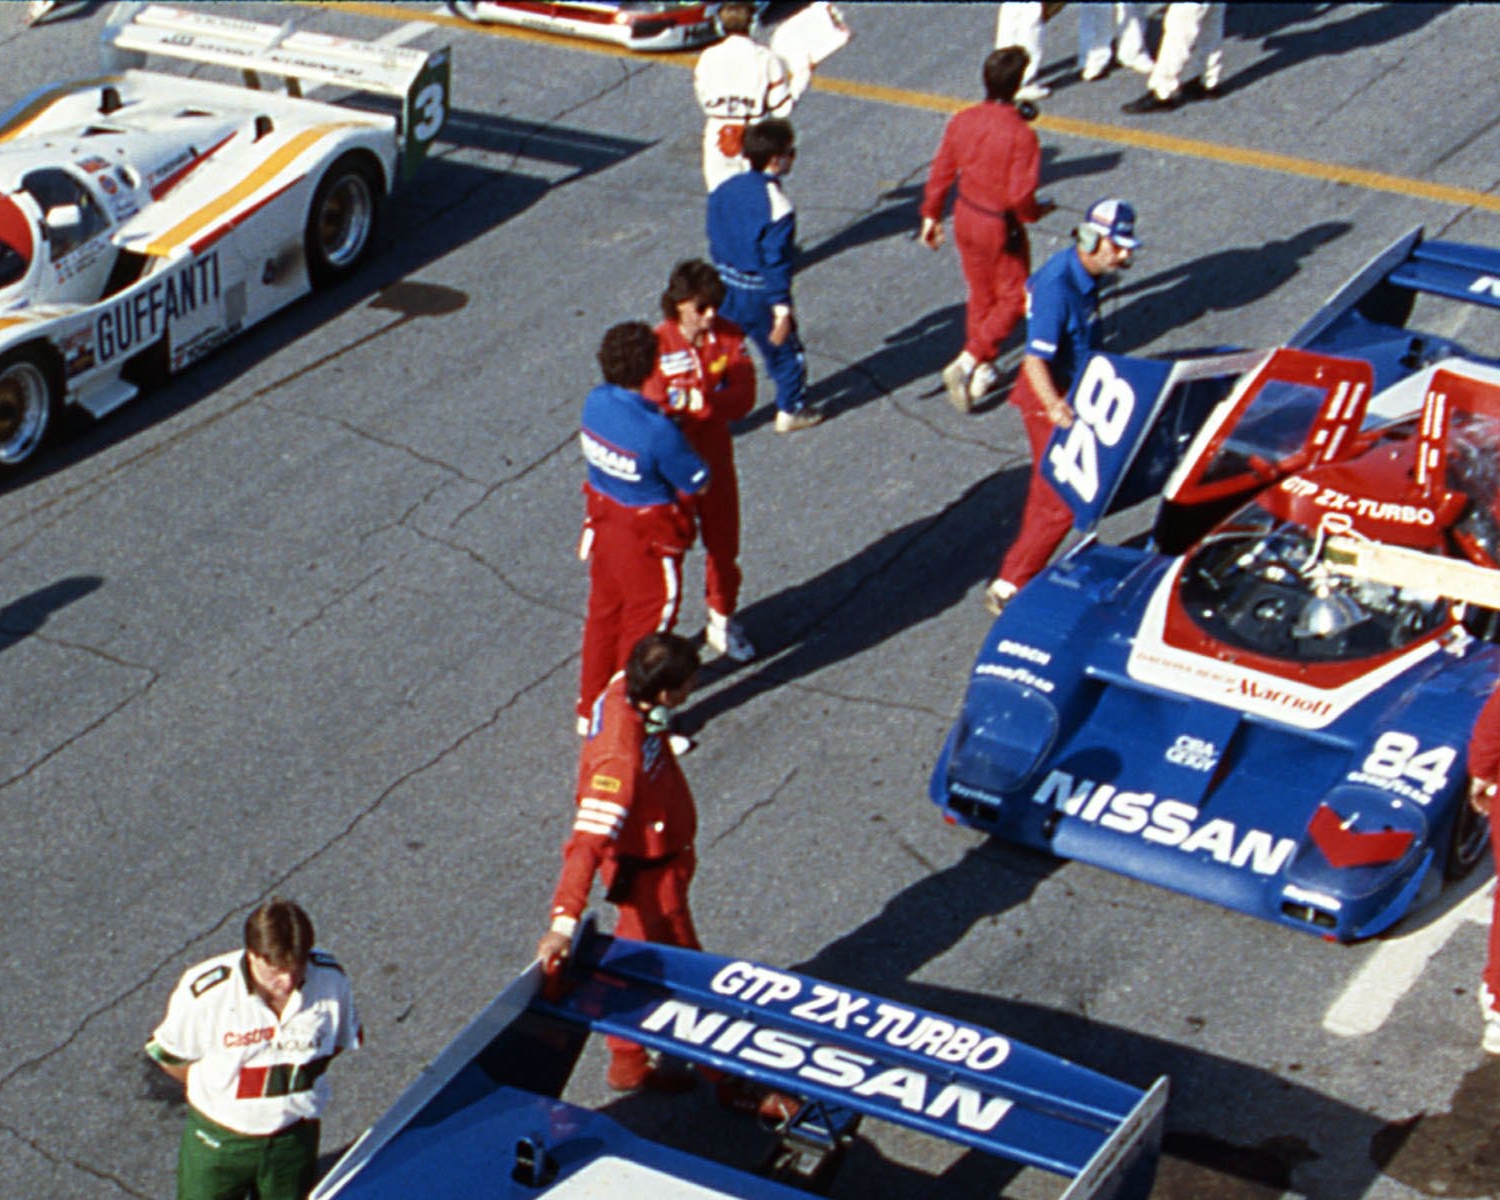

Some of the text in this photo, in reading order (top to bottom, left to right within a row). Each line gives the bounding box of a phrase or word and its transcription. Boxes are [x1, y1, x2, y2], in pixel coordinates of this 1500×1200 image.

[414, 83, 444, 142] 3
[96, 251, 220, 362] GUFFANTI
[1049, 355, 1135, 503] 84
[1281, 476, 1436, 526] GTP ZX-TURBO
[1226, 678, 1334, 718] Marriott
[1361, 731, 1457, 795] 84
[1032, 769, 1297, 875] NISSAN
[223, 1027, 276, 1048] Castro
[710, 961, 1011, 1072] GTP ZX-TURBO
[640, 1000, 1015, 1132] NISSAN
